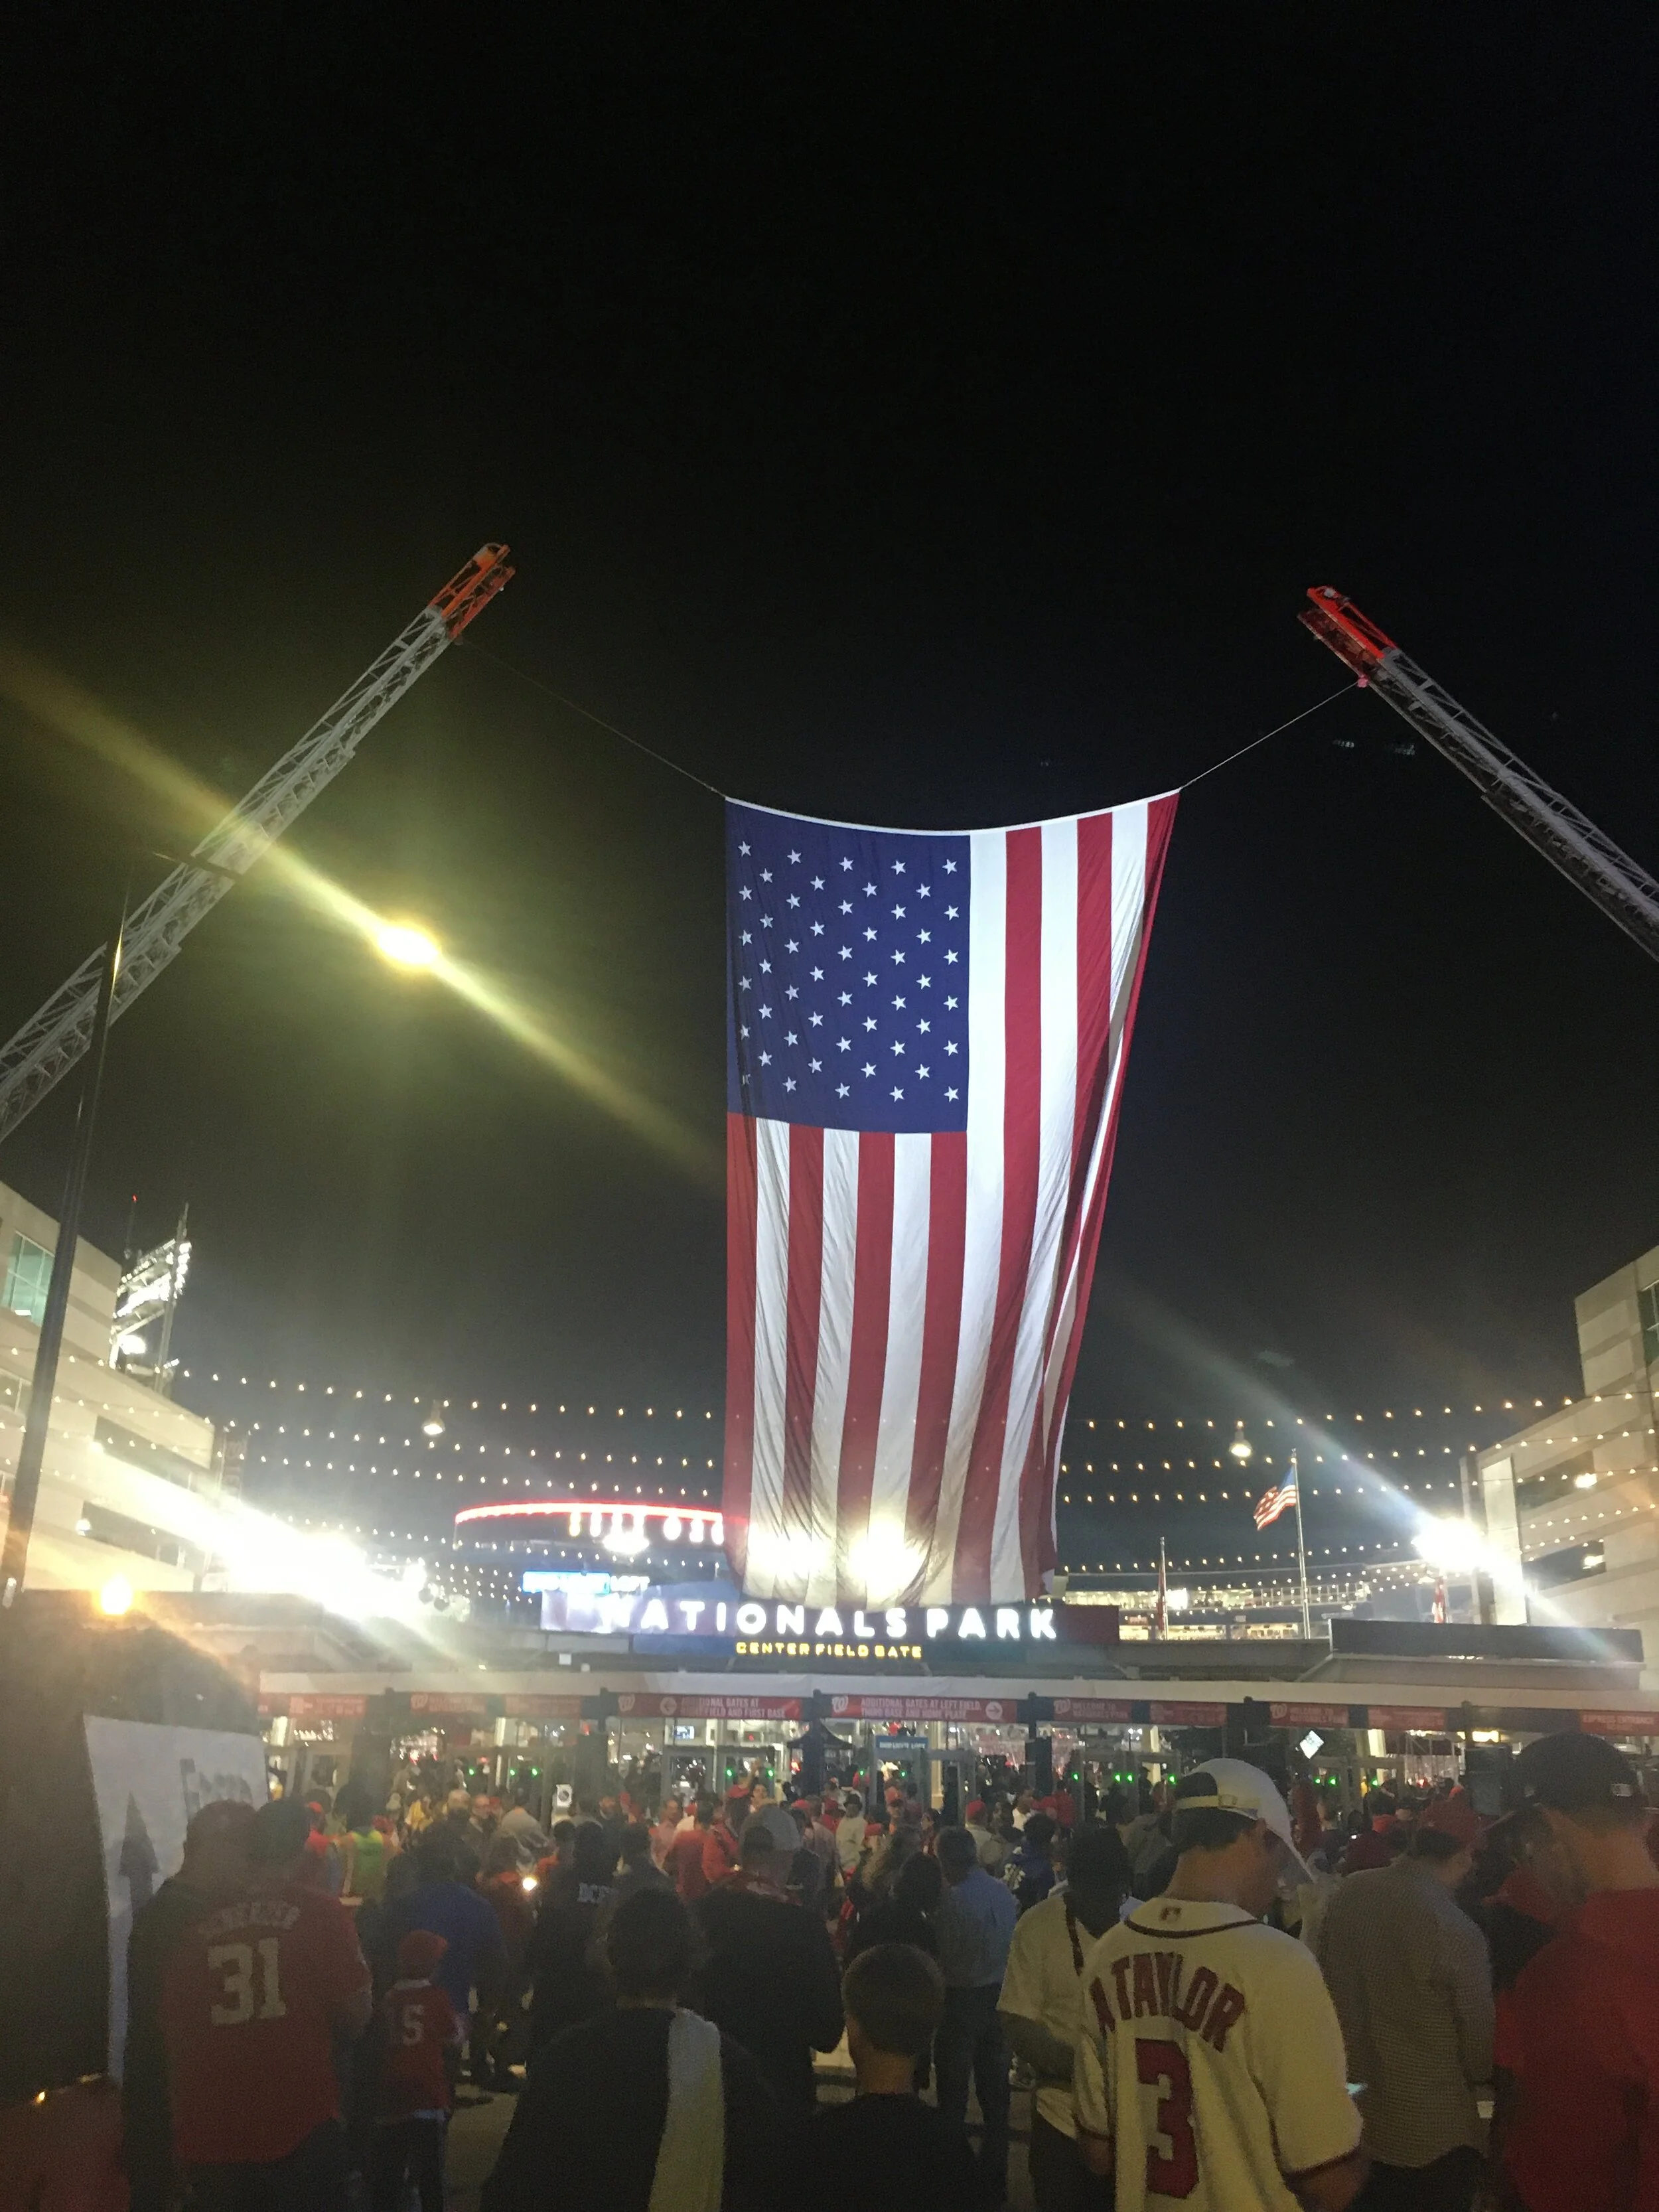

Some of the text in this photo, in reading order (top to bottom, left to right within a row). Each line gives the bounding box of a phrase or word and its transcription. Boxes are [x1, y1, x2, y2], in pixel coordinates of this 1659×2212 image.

[600, 1593, 1058, 1640] NATIONALS PARK
[735, 1641, 922, 1659] CENTER FIELD GATE
[208, 1937, 287, 2026] 31
[1111, 1951, 1246, 2053] TAYLOR
[402, 2004, 425, 2046] 5
[1135, 2038, 1200, 2199] 3
